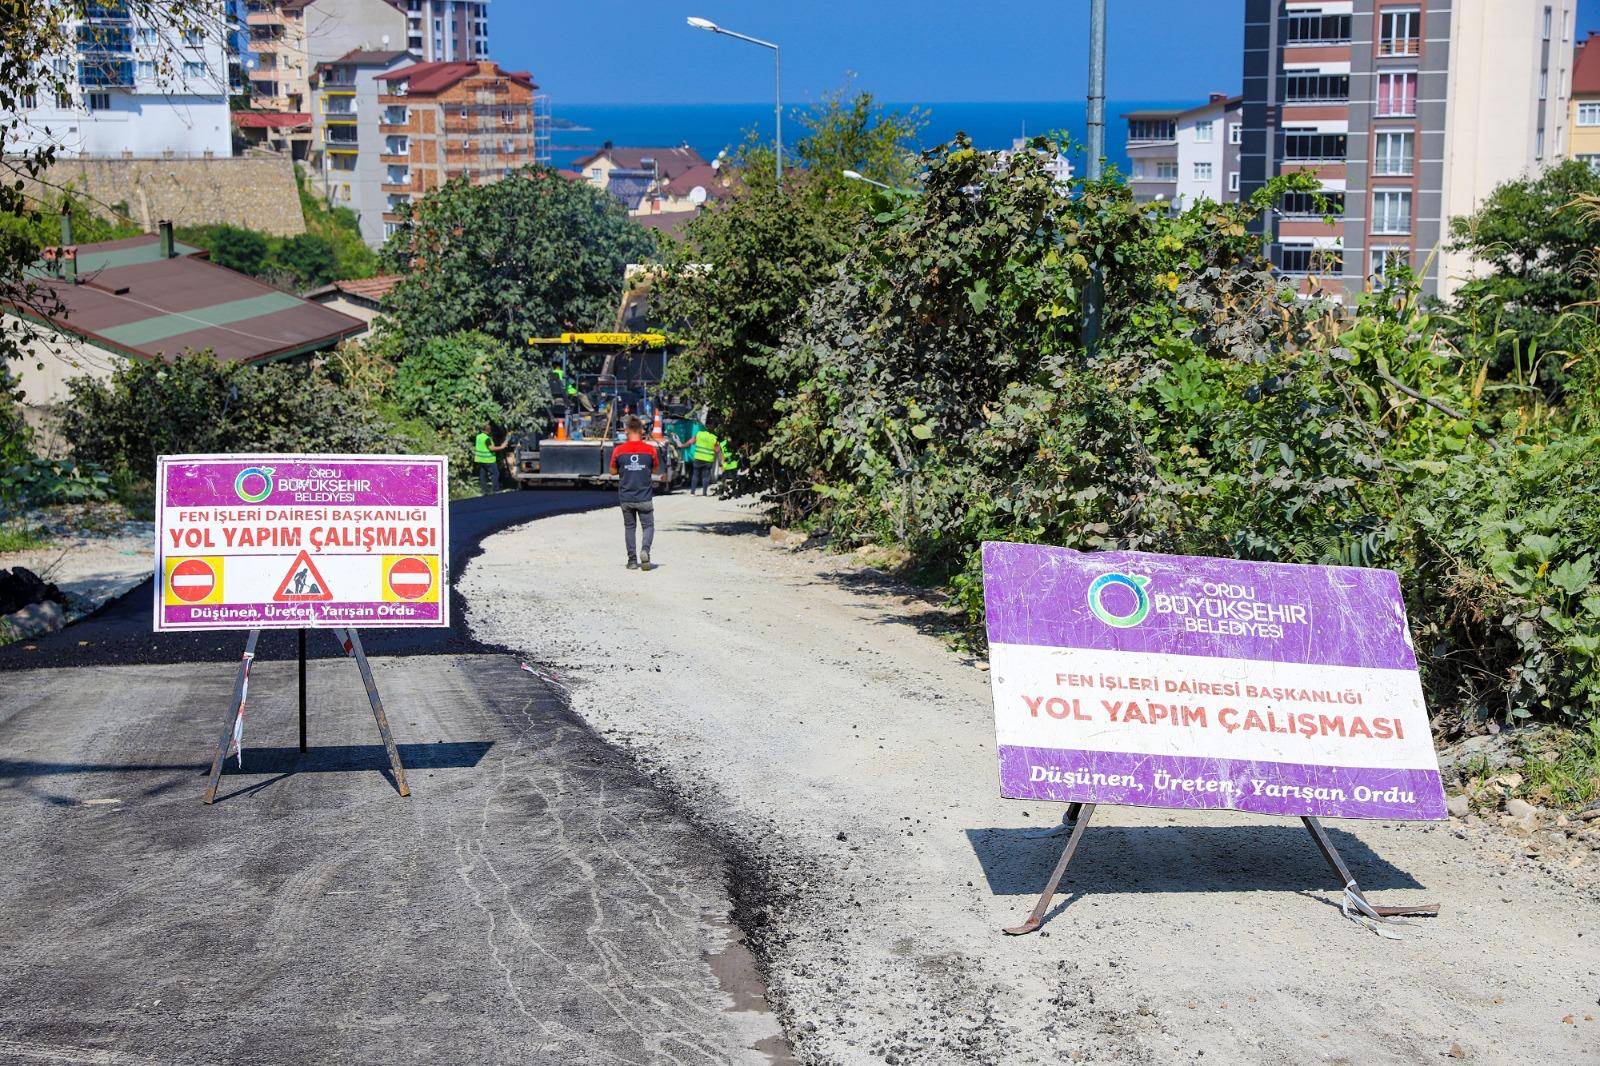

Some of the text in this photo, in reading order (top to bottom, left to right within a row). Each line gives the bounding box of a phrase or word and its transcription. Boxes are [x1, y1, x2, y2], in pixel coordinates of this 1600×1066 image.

[309, 469, 341, 478] ORDU
[179, 508, 427, 524] FEN İŞLERİ DAİRESİ BAŞKANLIĞI
[169, 527, 436, 552] YOL YAPIM ÇALIŞMASI
[1203, 582, 1255, 600] ORDU
[190, 604, 415, 621] Düşünen, Üreten, Yarışan Ordu
[1154, 594, 1308, 625] BÜYÜKŞEHİR
[1184, 617, 1284, 639] BELEDİYESİ
[1055, 673, 1363, 705] FEN İŞLERİ DAİRESİ BAŞKANLIĞI
[1021, 695, 1404, 740] YOL YAPIM ÇALIŞMASI
[1029, 766, 1416, 804] Düşünen, Üreten, Yarışan Ordu
